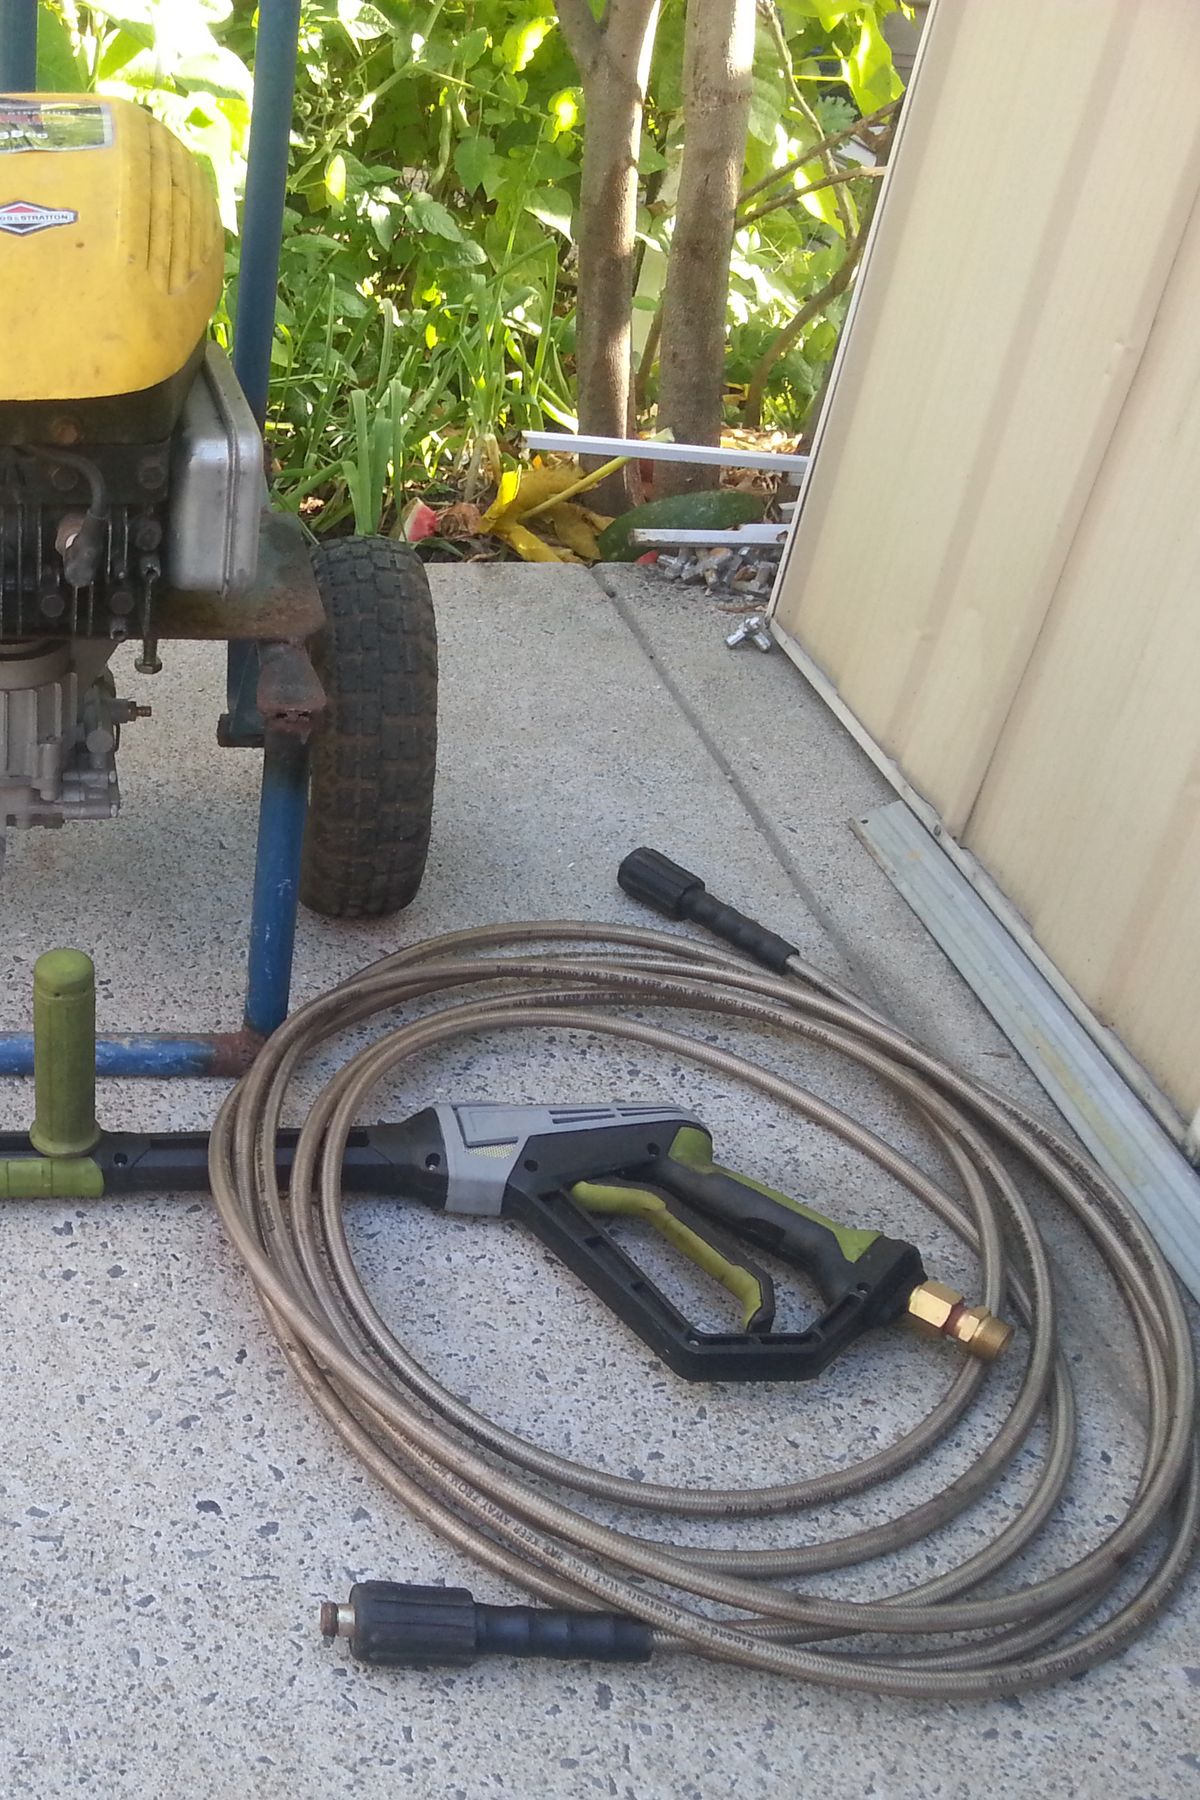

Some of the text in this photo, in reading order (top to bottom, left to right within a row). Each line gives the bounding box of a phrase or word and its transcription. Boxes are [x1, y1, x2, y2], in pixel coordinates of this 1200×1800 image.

[719, 996, 737, 1006] HOT
[426, 1456, 451, 1478] HOT
[450, 1476, 480, 1503] FROM
[481, 1501, 511, 1525] AWAY
[513, 1525, 540, 1547] KEEP
